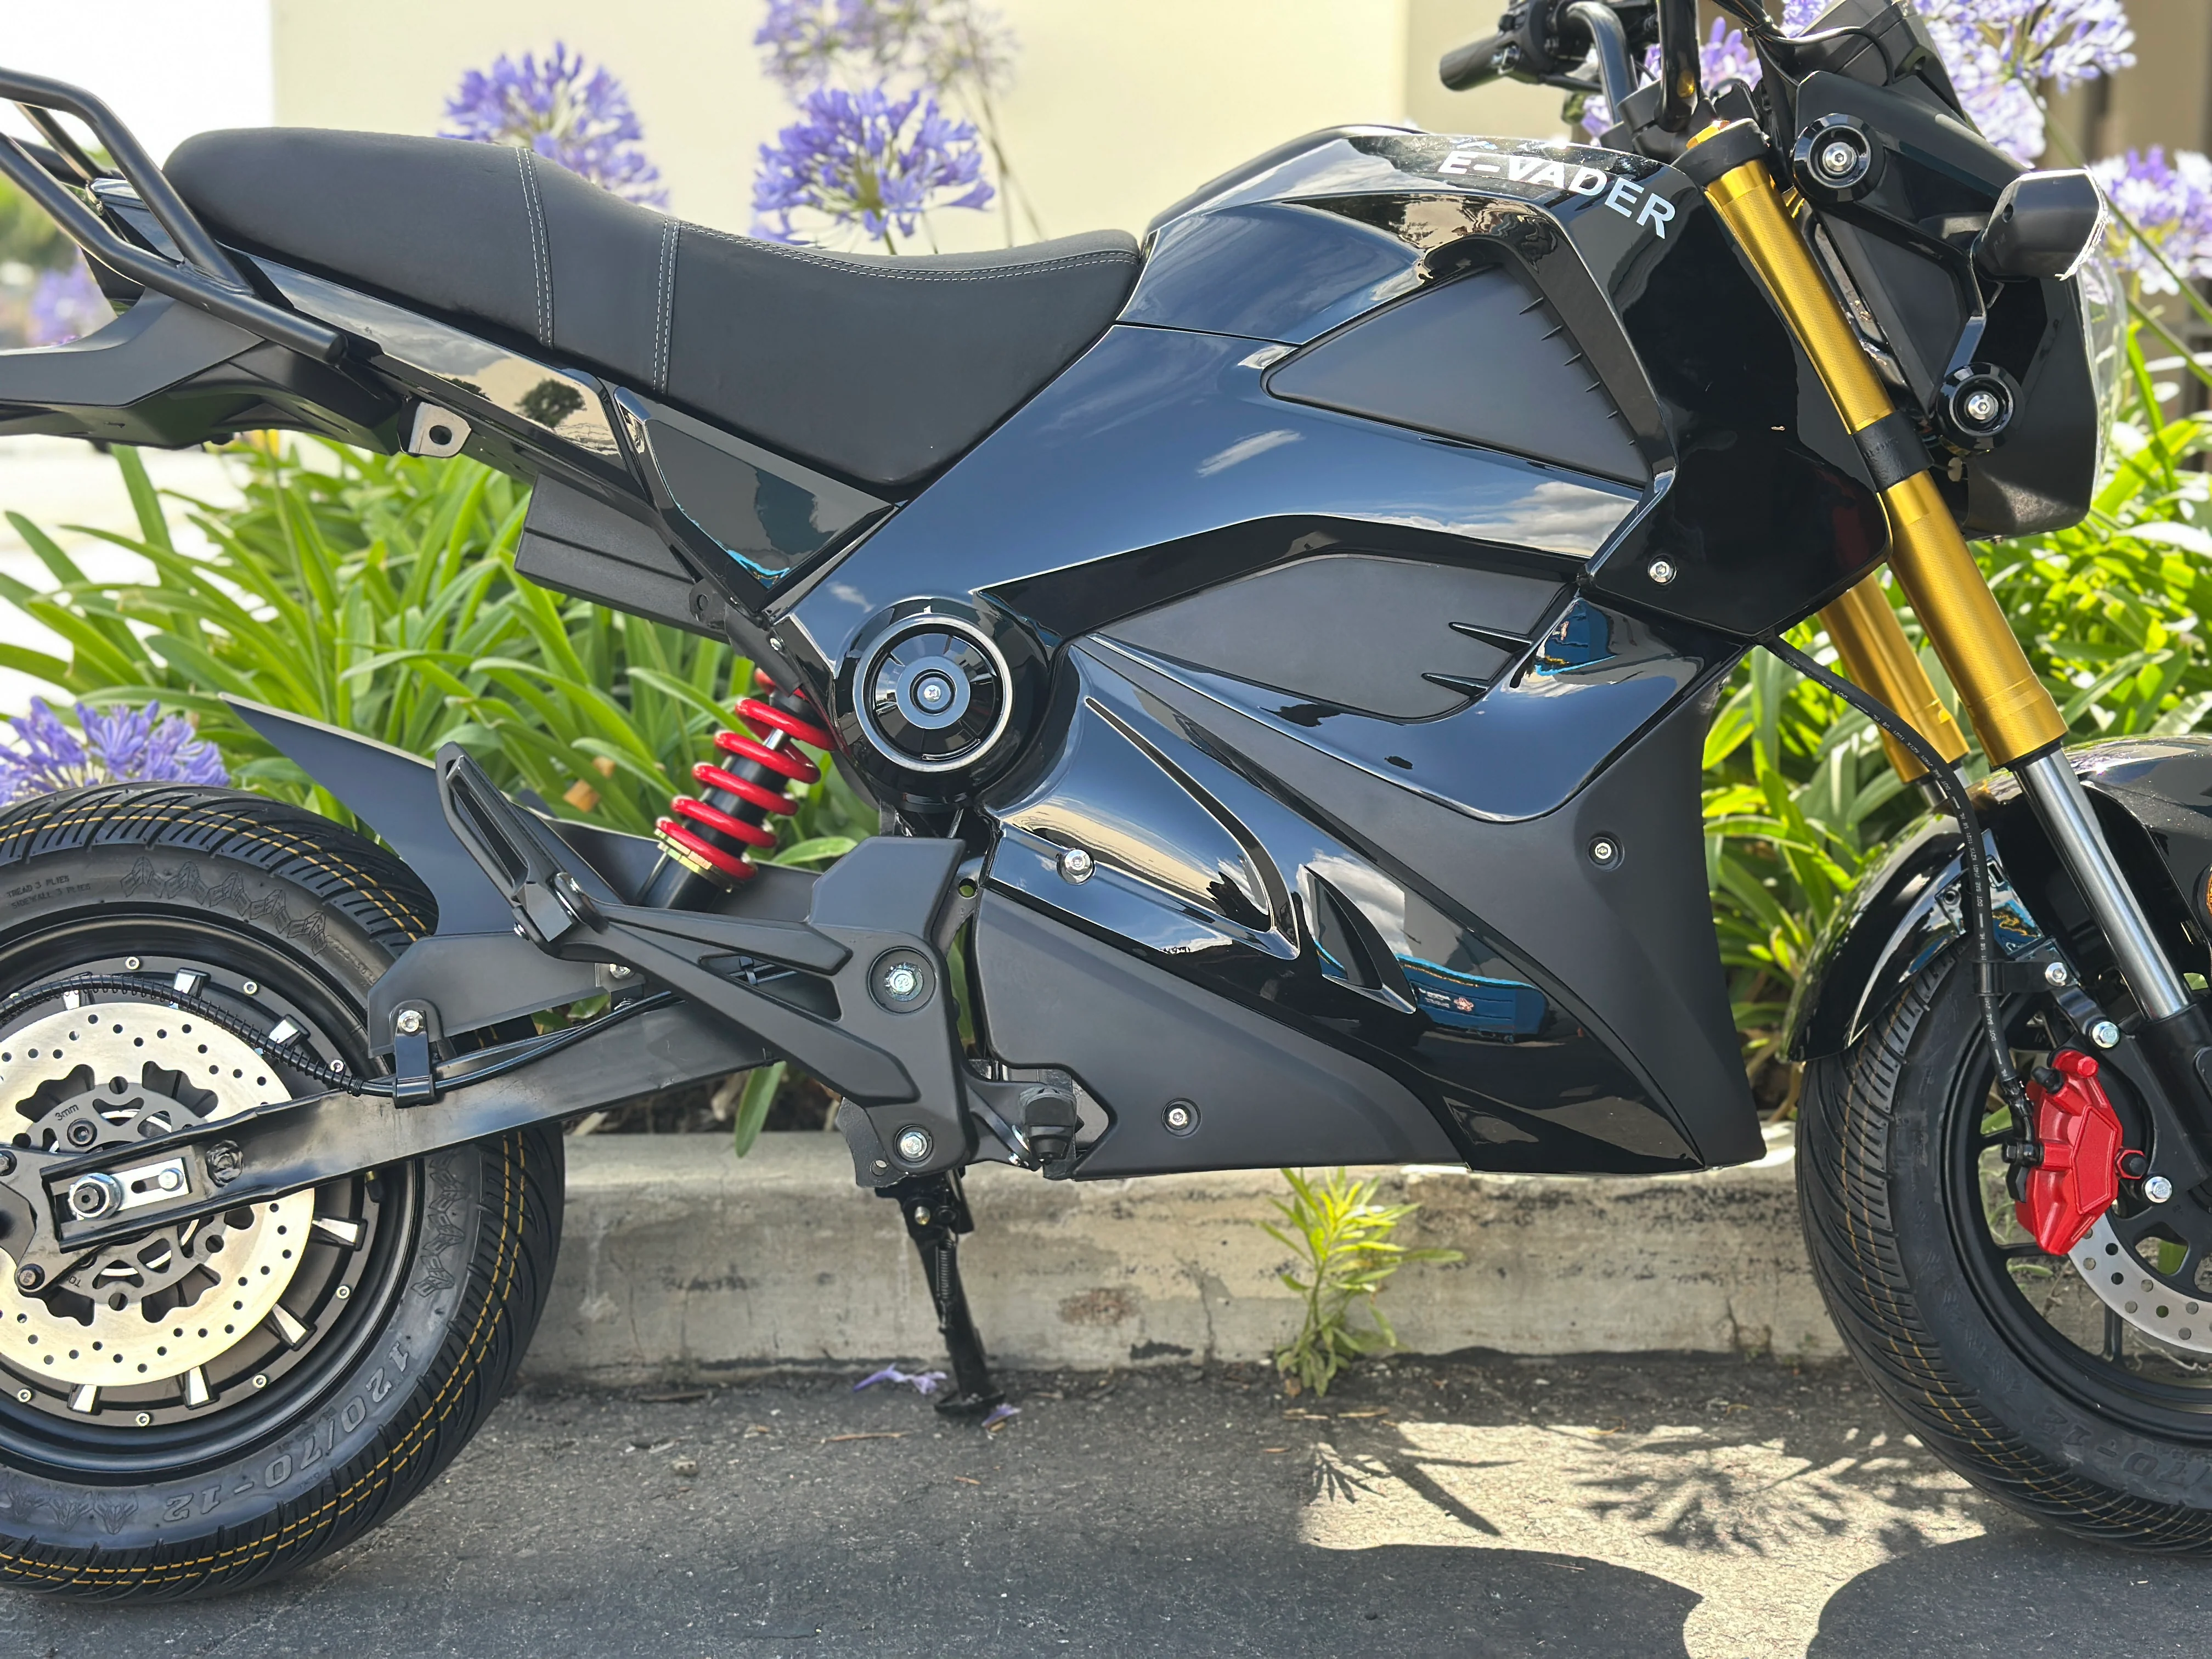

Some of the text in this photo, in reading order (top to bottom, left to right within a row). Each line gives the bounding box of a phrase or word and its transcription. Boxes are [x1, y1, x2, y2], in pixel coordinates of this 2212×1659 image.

[1438, 151, 1676, 239] E-VADER
[1941, 781, 1951, 791] DOT
[7, 885, 33, 898] TREAD
[46, 875, 70, 886] PLIES
[11, 892, 52, 909] SIDEWALL
[66, 883, 91, 894] PLIES
[55, 1104, 79, 1121] 3mm
[163, 1341, 409, 1522] 120/70-12
